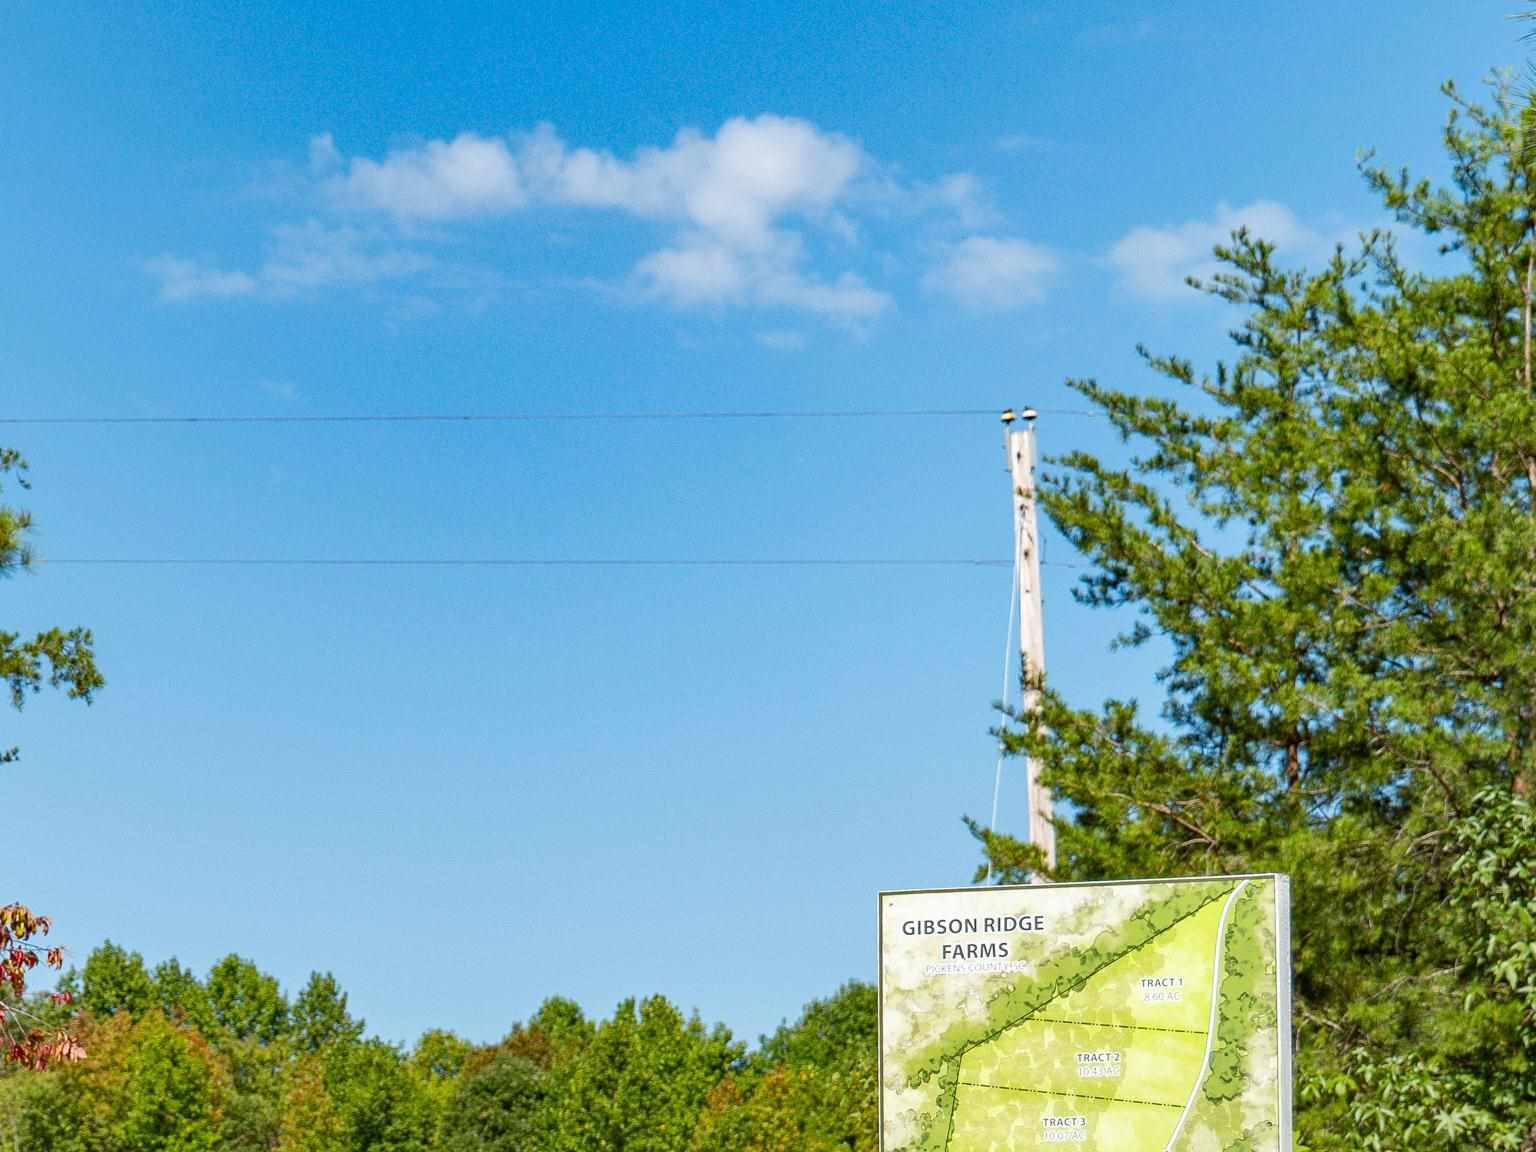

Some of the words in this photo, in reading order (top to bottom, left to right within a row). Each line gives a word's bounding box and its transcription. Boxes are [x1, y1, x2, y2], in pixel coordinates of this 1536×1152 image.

[902, 918, 977, 936] GIBSON
[984, 915, 1045, 932] RIDGE
[942, 942, 1009, 960] FARMS
[1141, 977, 1174, 988] TRACT
[1178, 977, 1183, 987] 1
[1077, 1052, 1111, 1062] TRACT
[1114, 1052, 1121, 1062] 2
[1042, 1117, 1076, 1127] TRACT
[1080, 1117, 1086, 1126] 3
